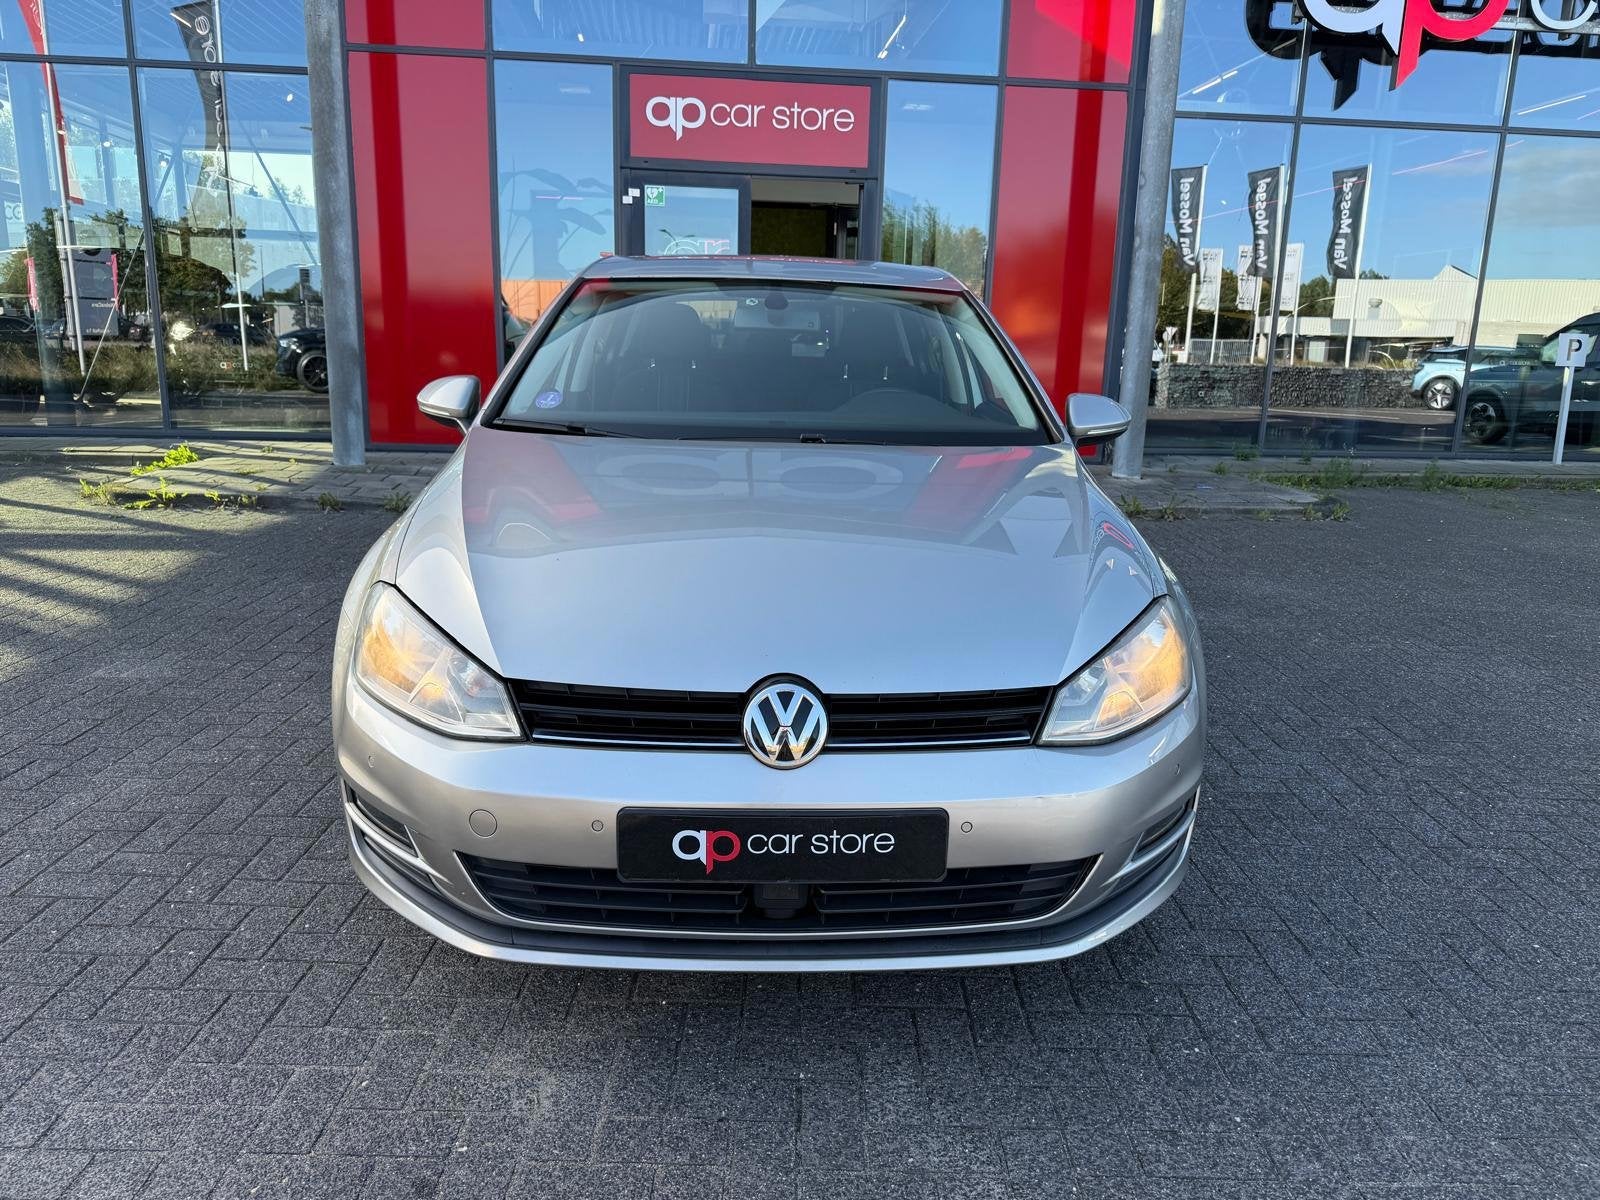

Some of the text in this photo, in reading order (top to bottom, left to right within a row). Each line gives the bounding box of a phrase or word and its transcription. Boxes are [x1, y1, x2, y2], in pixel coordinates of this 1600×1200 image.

[645, 96, 855, 141] ap car store
[1566, 338, 1583, 361] P
[672, 829, 895, 875] ap car store
